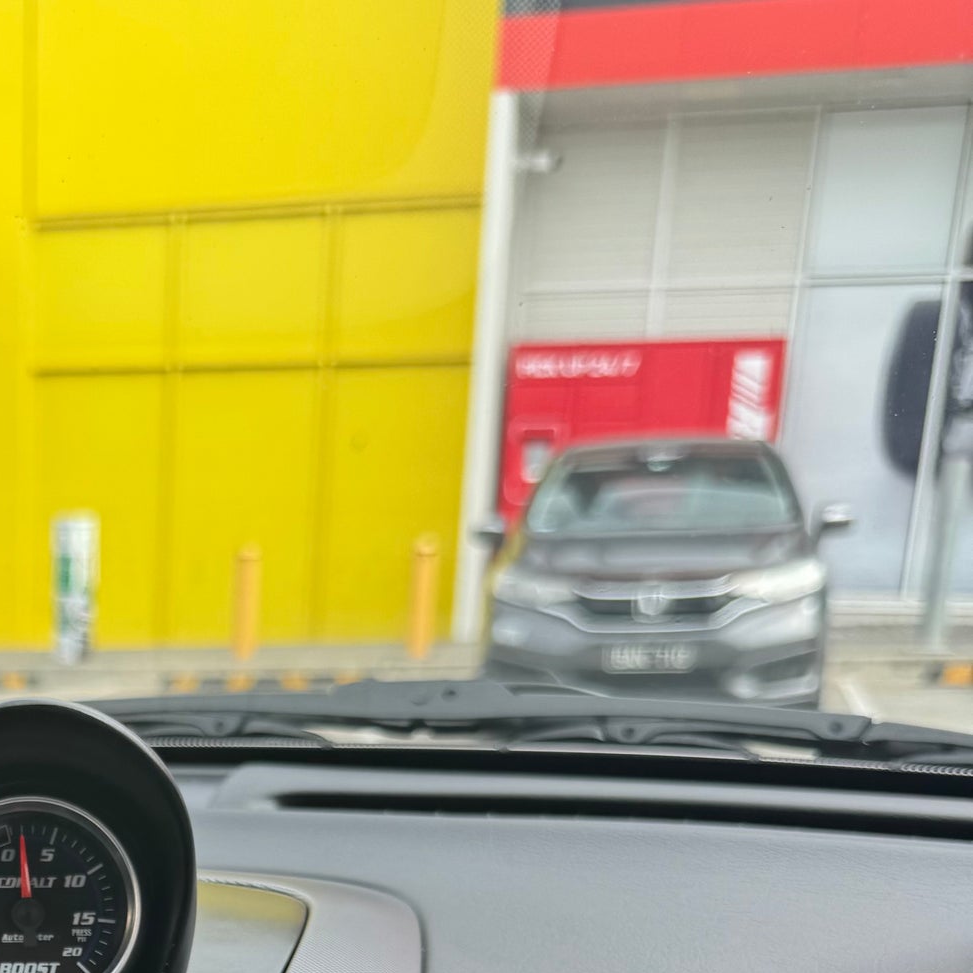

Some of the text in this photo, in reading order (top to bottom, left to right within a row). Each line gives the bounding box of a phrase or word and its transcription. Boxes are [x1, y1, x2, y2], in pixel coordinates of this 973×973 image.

[0, 848, 15, 862] 0
[39, 848, 55, 862] 5
[63, 874, 87, 888] 10
[72, 911, 96, 925] 15
[1, 933, 25, 943] Auto
[62, 947, 83, 957] 20
